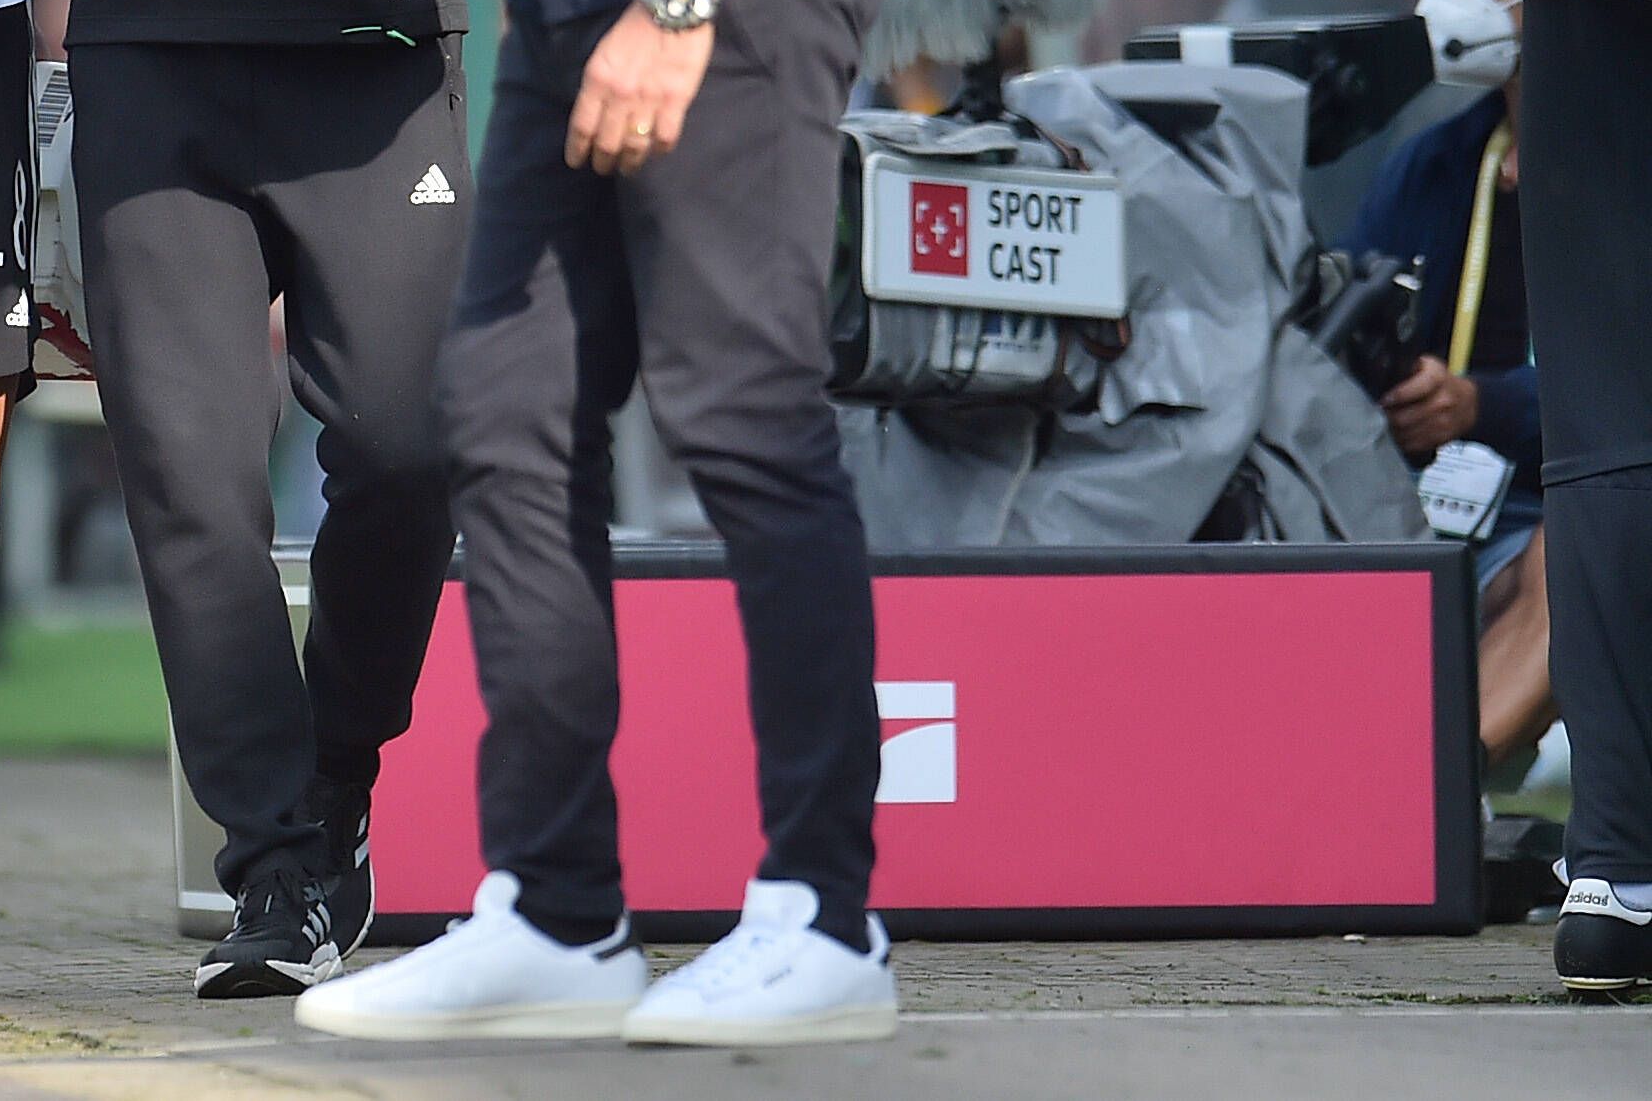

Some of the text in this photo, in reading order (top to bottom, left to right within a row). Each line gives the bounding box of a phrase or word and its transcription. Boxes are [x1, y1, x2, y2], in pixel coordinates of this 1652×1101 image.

[988, 189, 1083, 235] SPORT
[988, 242, 1063, 286] CAST
[1567, 891, 1609, 907] adidas
